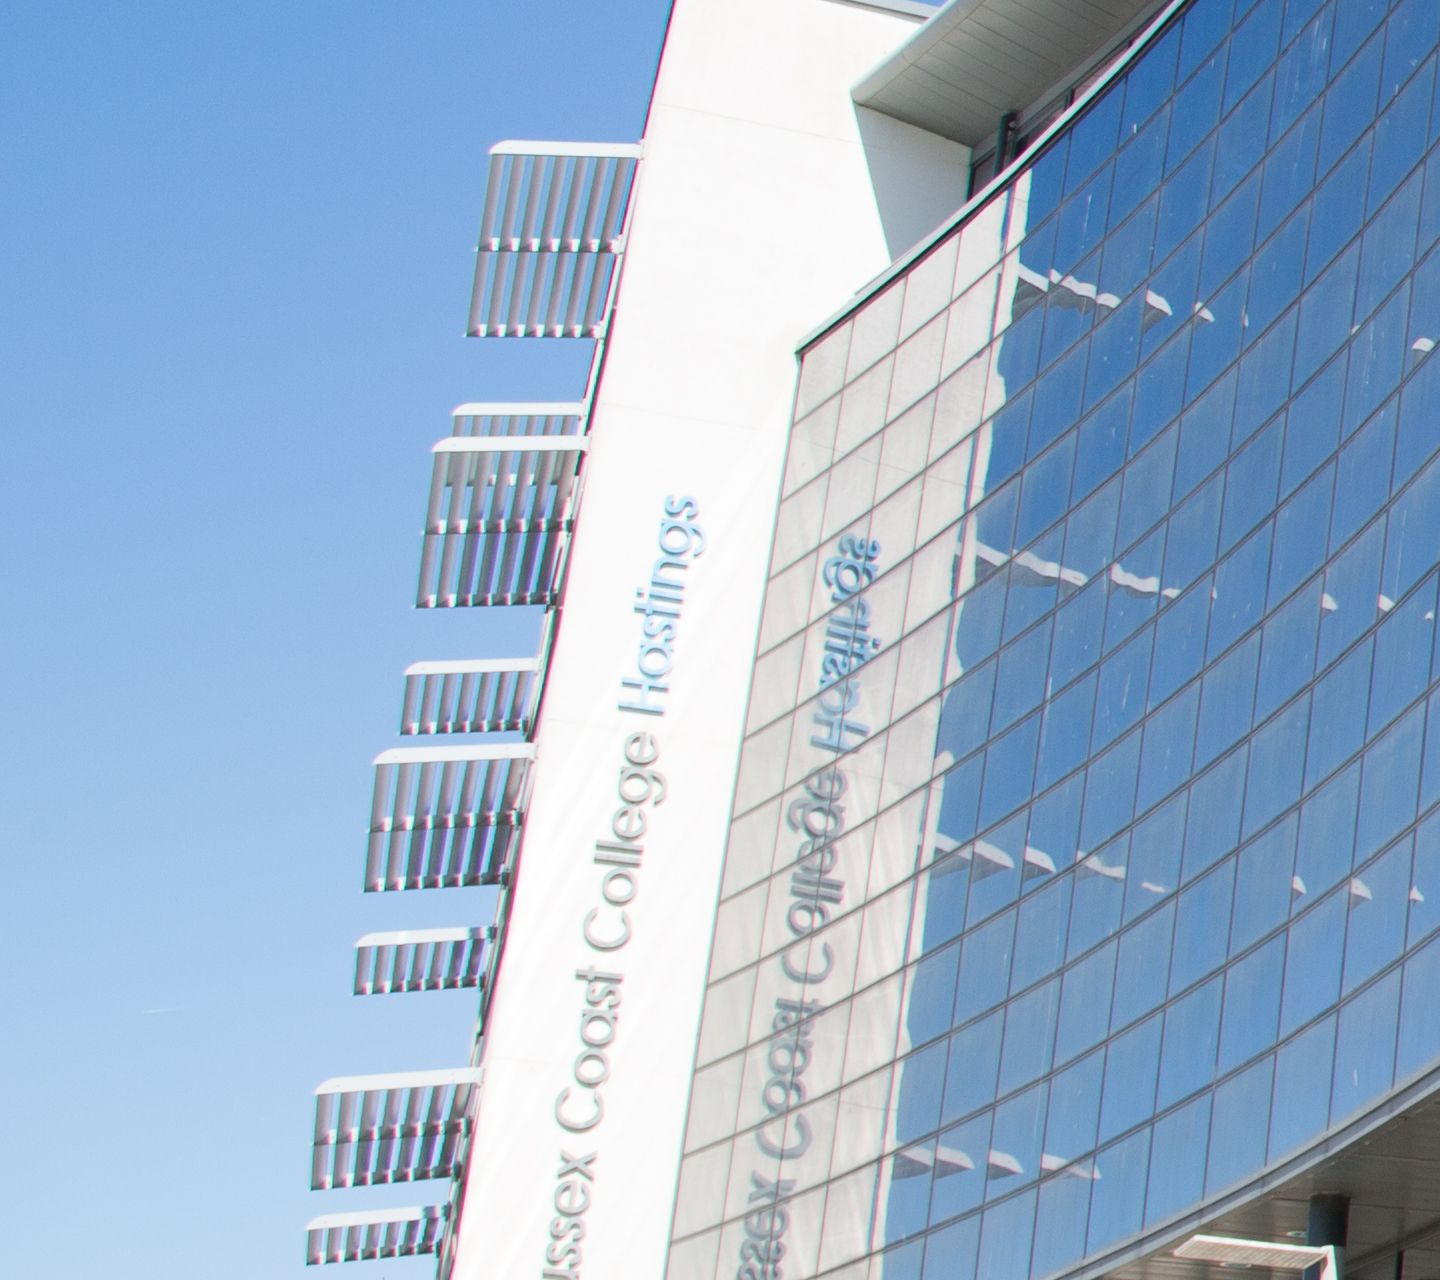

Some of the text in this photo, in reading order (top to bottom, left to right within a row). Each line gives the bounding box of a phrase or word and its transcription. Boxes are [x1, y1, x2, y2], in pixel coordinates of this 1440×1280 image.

[616, 492, 706, 719] Hastings
[581, 730, 669, 955] College
[553, 963, 628, 1137] Coast
